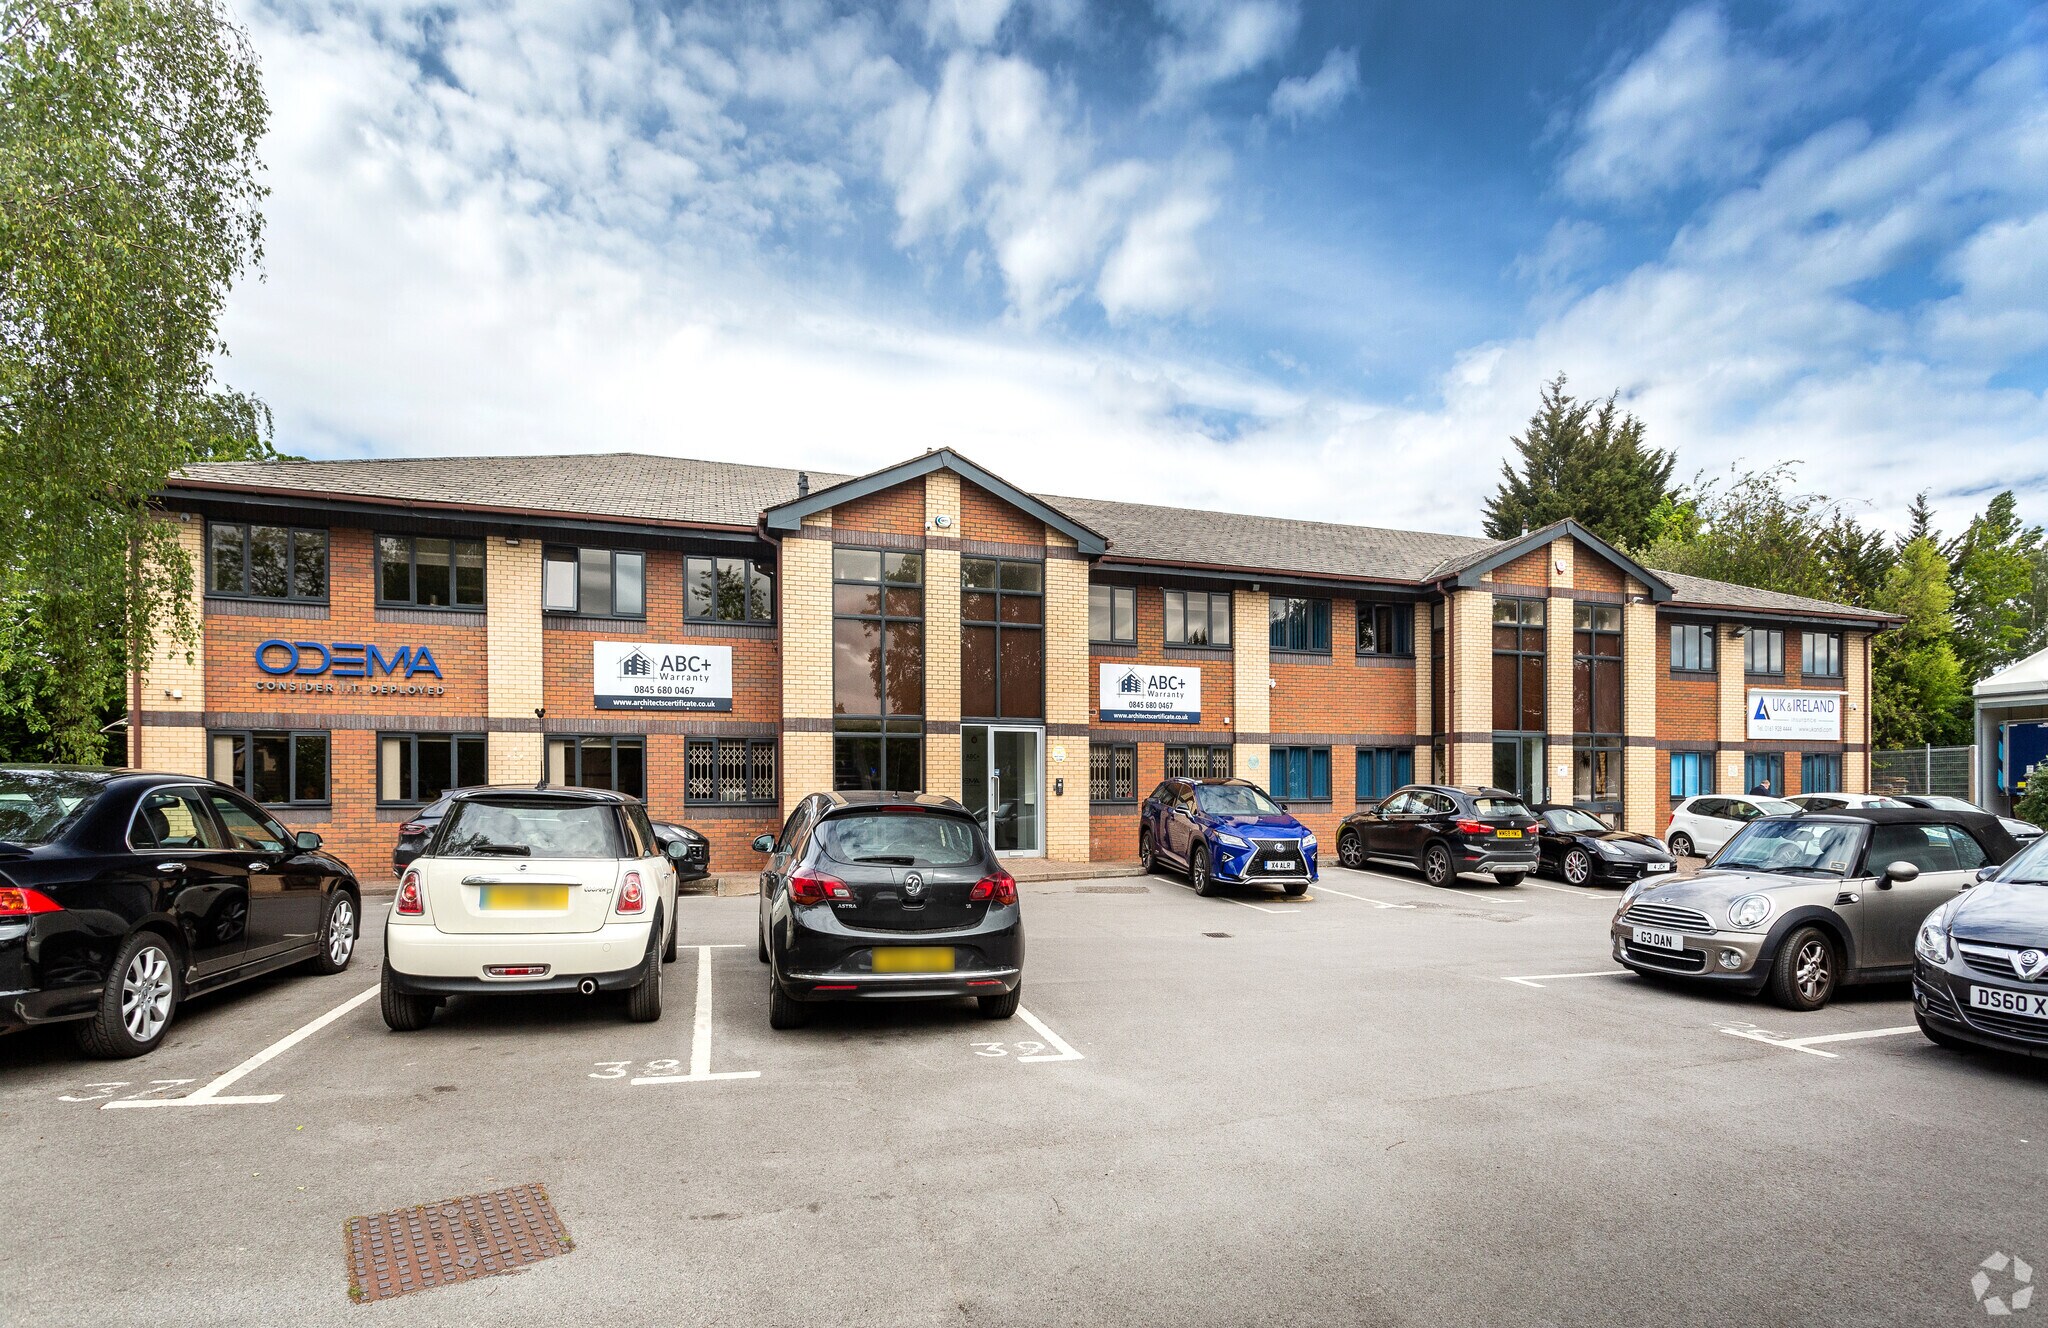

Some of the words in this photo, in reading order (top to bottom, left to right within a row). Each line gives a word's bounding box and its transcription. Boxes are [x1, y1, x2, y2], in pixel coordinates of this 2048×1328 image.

[255, 639, 443, 679] ODEMA
[660, 654, 712, 672] ABC+
[659, 672, 710, 683] Warranty
[1147, 675, 1186, 690] ABC+
[256, 681, 334, 693] CONSIDER
[370, 685, 445, 695] DEPLOYED
[634, 685, 655, 694] 0845
[657, 685, 673, 694] 680
[674, 686, 695, 695] 0467
[1147, 690, 1184, 699] Warranty
[612, 698, 716, 708] www.architectscertificate.co.uk
[1128, 701, 1144, 709] 0845
[1145, 701, 1157, 709] 680
[1159, 702, 1174, 710] 0467
[1113, 712, 1189, 720] www.architectscertificate.co.uk
[1641, 931, 1652, 944] G3
[1978, 988, 2027, 1012] DS60
[969, 1041, 1046, 1057] 39
[587, 1059, 681, 1078] 38
[58, 1078, 197, 1102] 37
